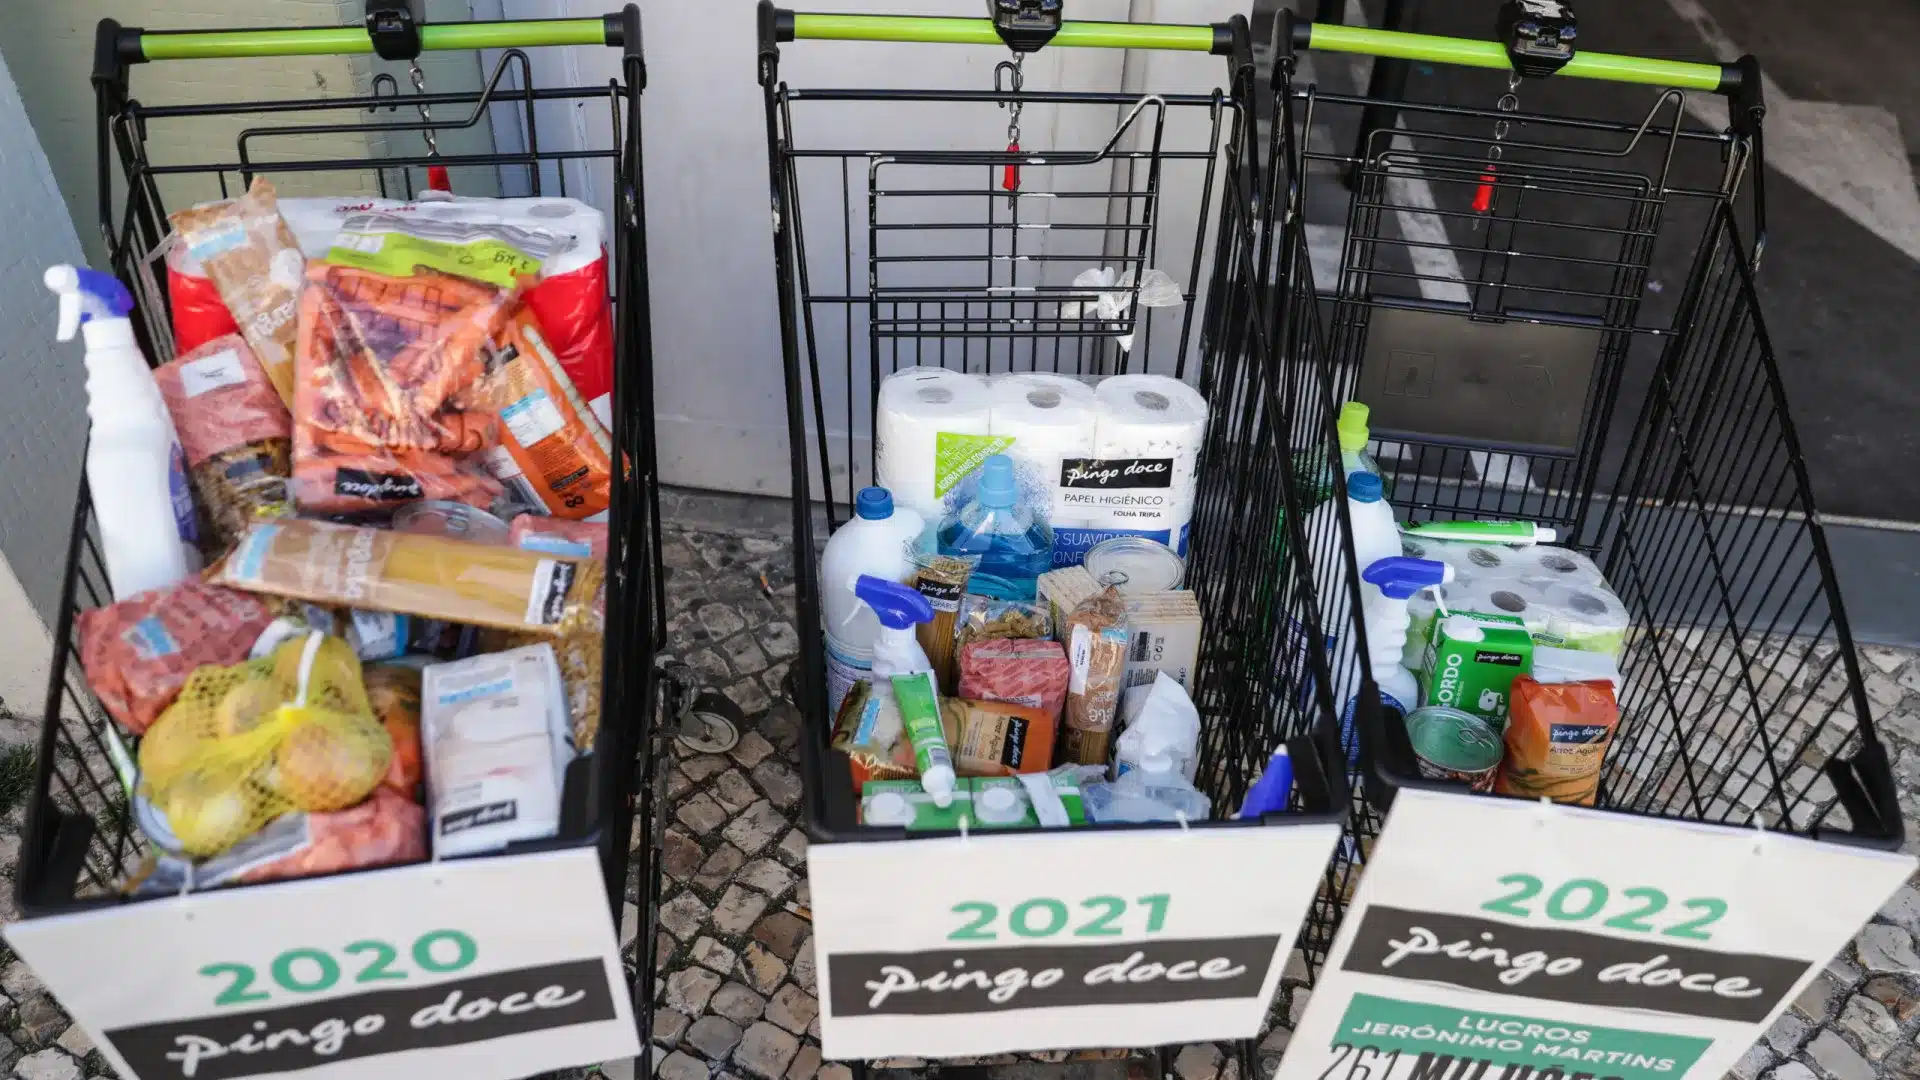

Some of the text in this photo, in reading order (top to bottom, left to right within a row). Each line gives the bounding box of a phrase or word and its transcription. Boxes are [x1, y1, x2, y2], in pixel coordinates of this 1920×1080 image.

[1066, 460, 1167, 486] pingo doce
[1064, 493, 1163, 506] PAPEL HIGIÉNICO
[919, 582, 947, 596] pingo
[1436, 653, 1463, 707] ORDO
[1476, 653, 1521, 663] pingo doce
[1009, 720, 1023, 766] pingo doce
[1550, 746, 1574, 755] Arroz
[1552, 726, 1606, 740] pingo doce
[946, 893, 1172, 941] 2021
[1480, 872, 1729, 941] 2022
[198, 928, 479, 1006] 2020
[864, 951, 1247, 1009] pingo doce
[1381, 925, 1763, 998] pingo doce
[165, 984, 587, 1078] pingo doce
[1351, 1020, 1677, 1072] JERÓNIMO MARTINS
[1457, 1015, 1592, 1045] LUCROS
[1318, 1042, 1402, 1080] 261
